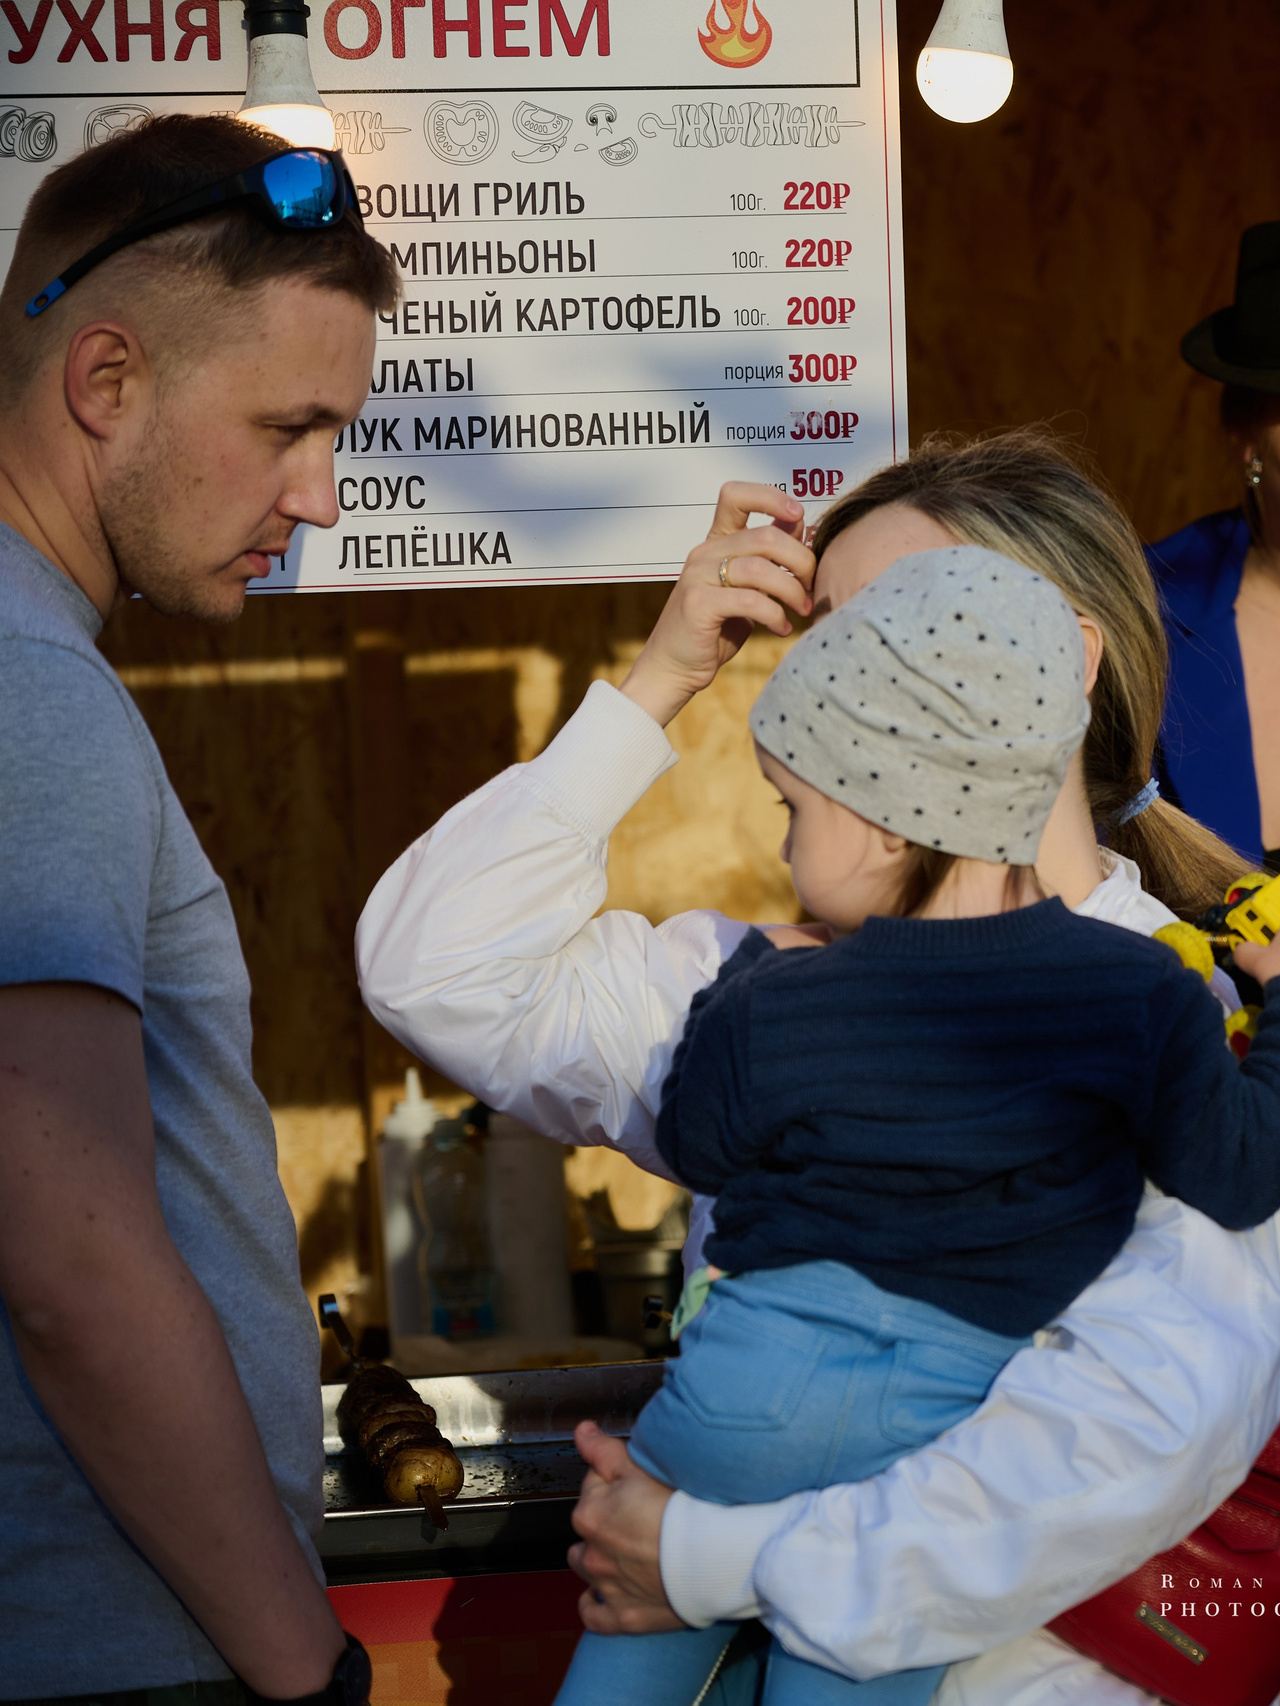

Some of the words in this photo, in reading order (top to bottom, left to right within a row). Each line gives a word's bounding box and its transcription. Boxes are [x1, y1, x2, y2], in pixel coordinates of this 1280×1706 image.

[356, 183, 460, 222] ВОЩИ
[473, 181, 586, 217] ГРИЛЬ
[730, 193, 766, 211] 100г.
[783, 181, 851, 210] 220₽
[390, 239, 596, 276] МПИНЬОНЫ
[732, 251, 768, 269] 100г.
[785, 238, 852, 268] 220₽
[516, 294, 721, 332] КАРТОФЕЛЬ
[733, 308, 770, 326] 100г.
[787, 295, 856, 325] 200₽
[724, 365, 784, 383] порция
[788, 353, 858, 383] 300₽
[335, 418, 403, 453] ЛУК
[413, 402, 711, 451] МАРИНОВАННЫЙ
[726, 425, 785, 441] порция
[338, 475, 426, 511] СОУС
[792, 468, 844, 497] 50₽
[339, 525, 512, 570] ЛЕПЁШКА
